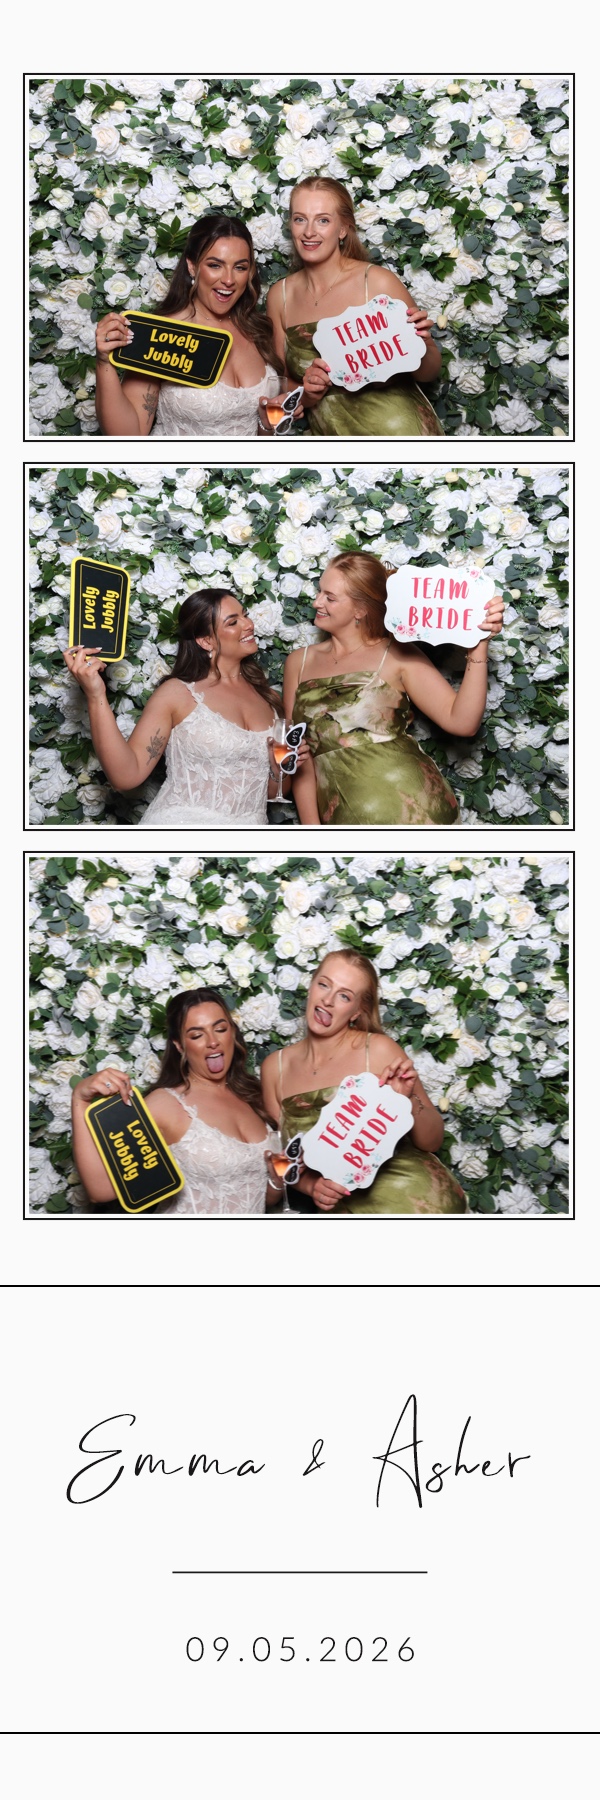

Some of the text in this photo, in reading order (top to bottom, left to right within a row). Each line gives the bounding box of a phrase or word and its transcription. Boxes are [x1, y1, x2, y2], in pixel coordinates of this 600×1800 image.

[149, 328, 200, 353] Lovely
[332, 311, 389, 347] TEAM
[143, 347, 194, 374] Jubbly
[344, 334, 409, 374] BRIDE
[82, 586, 100, 630] Lovely
[411, 577, 469, 600] TEAM
[101, 590, 120, 633] Jubbly
[408, 606, 474, 631] BRIDE
[317, 1093, 368, 1149] TEAM
[343, 1103, 399, 1169] BRIDE
[108, 1131, 139, 1182] Jubbly
[126, 1119, 159, 1170] Lovely
